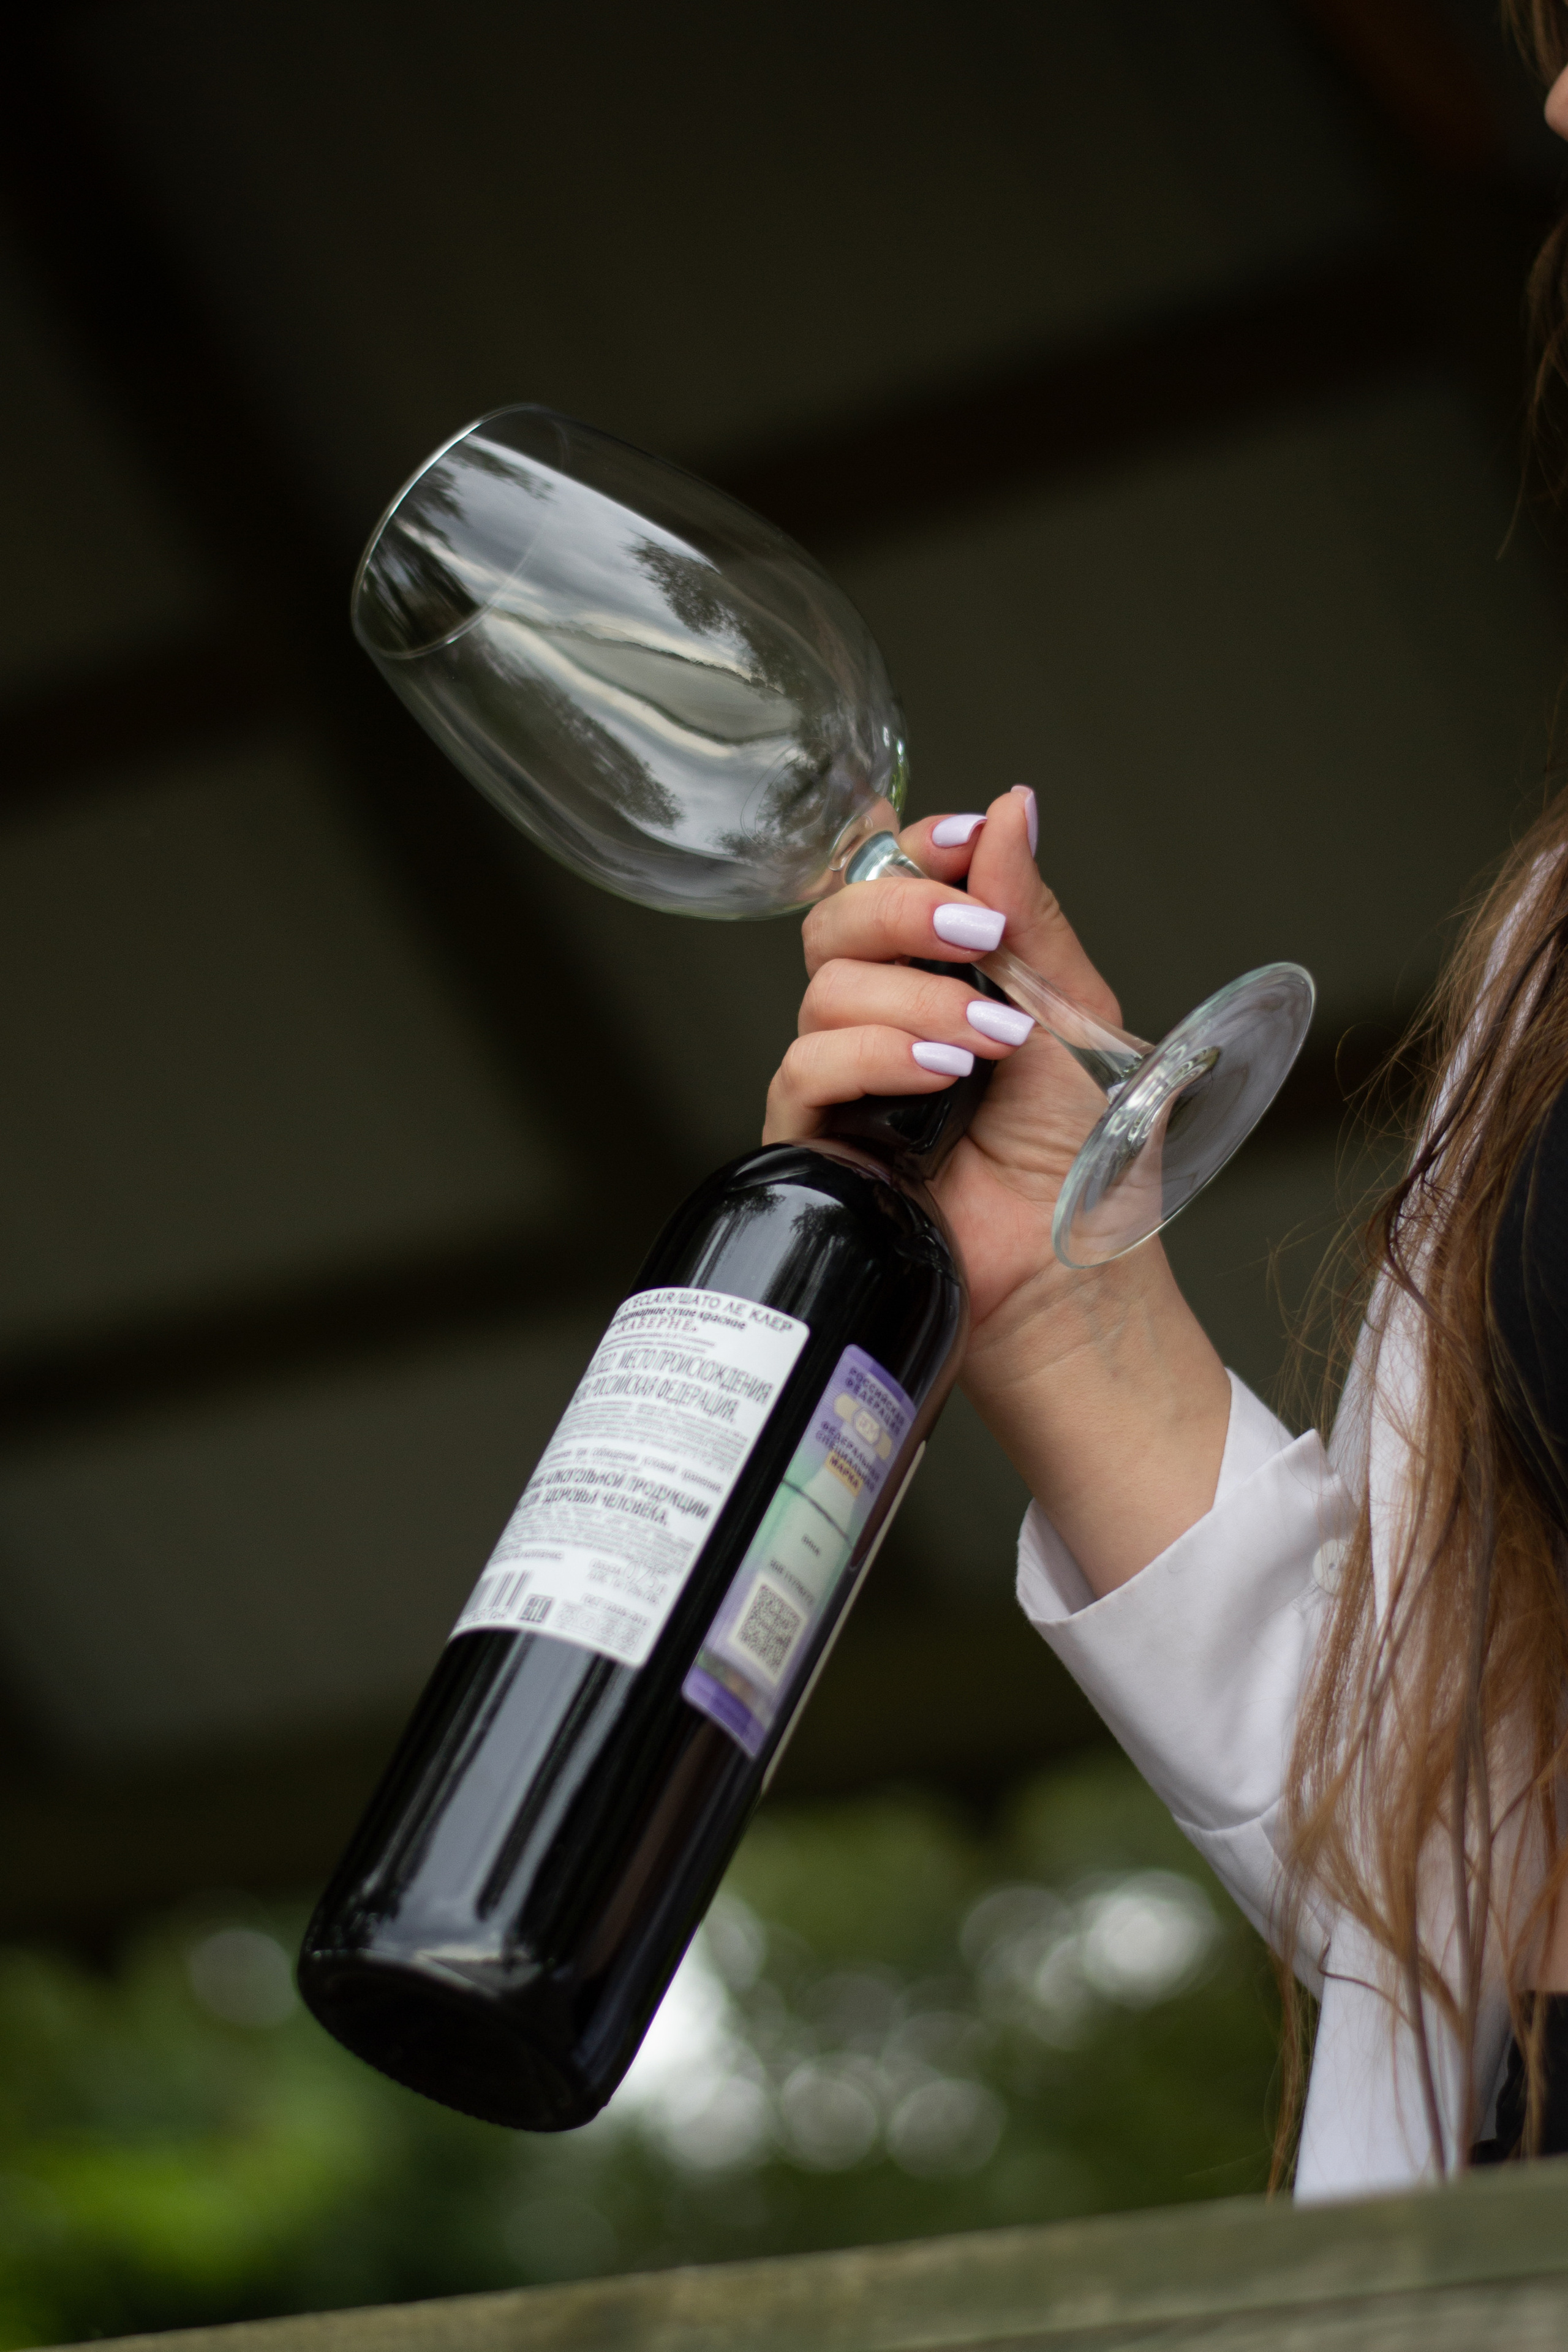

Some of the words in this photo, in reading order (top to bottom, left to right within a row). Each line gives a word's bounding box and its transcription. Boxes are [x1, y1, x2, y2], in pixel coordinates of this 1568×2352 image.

[699, 1311, 747, 1330] красное
[723, 1301, 744, 1317] ЛЕ
[749, 1308, 794, 1333] КЛЕР
[618, 1348, 657, 1373] МЕСТО
[657, 1349, 775, 1406] ПРОИСХОЖДЕНИЯ
[849, 1366, 905, 1426] РОССИЙСКАЯ
[845, 1378, 901, 1435] ФЕДЕРАЦИЯ
[830, 1455, 859, 1488] МАРКА
[627, 1473, 712, 1520] ПРОДУКЦИИ
